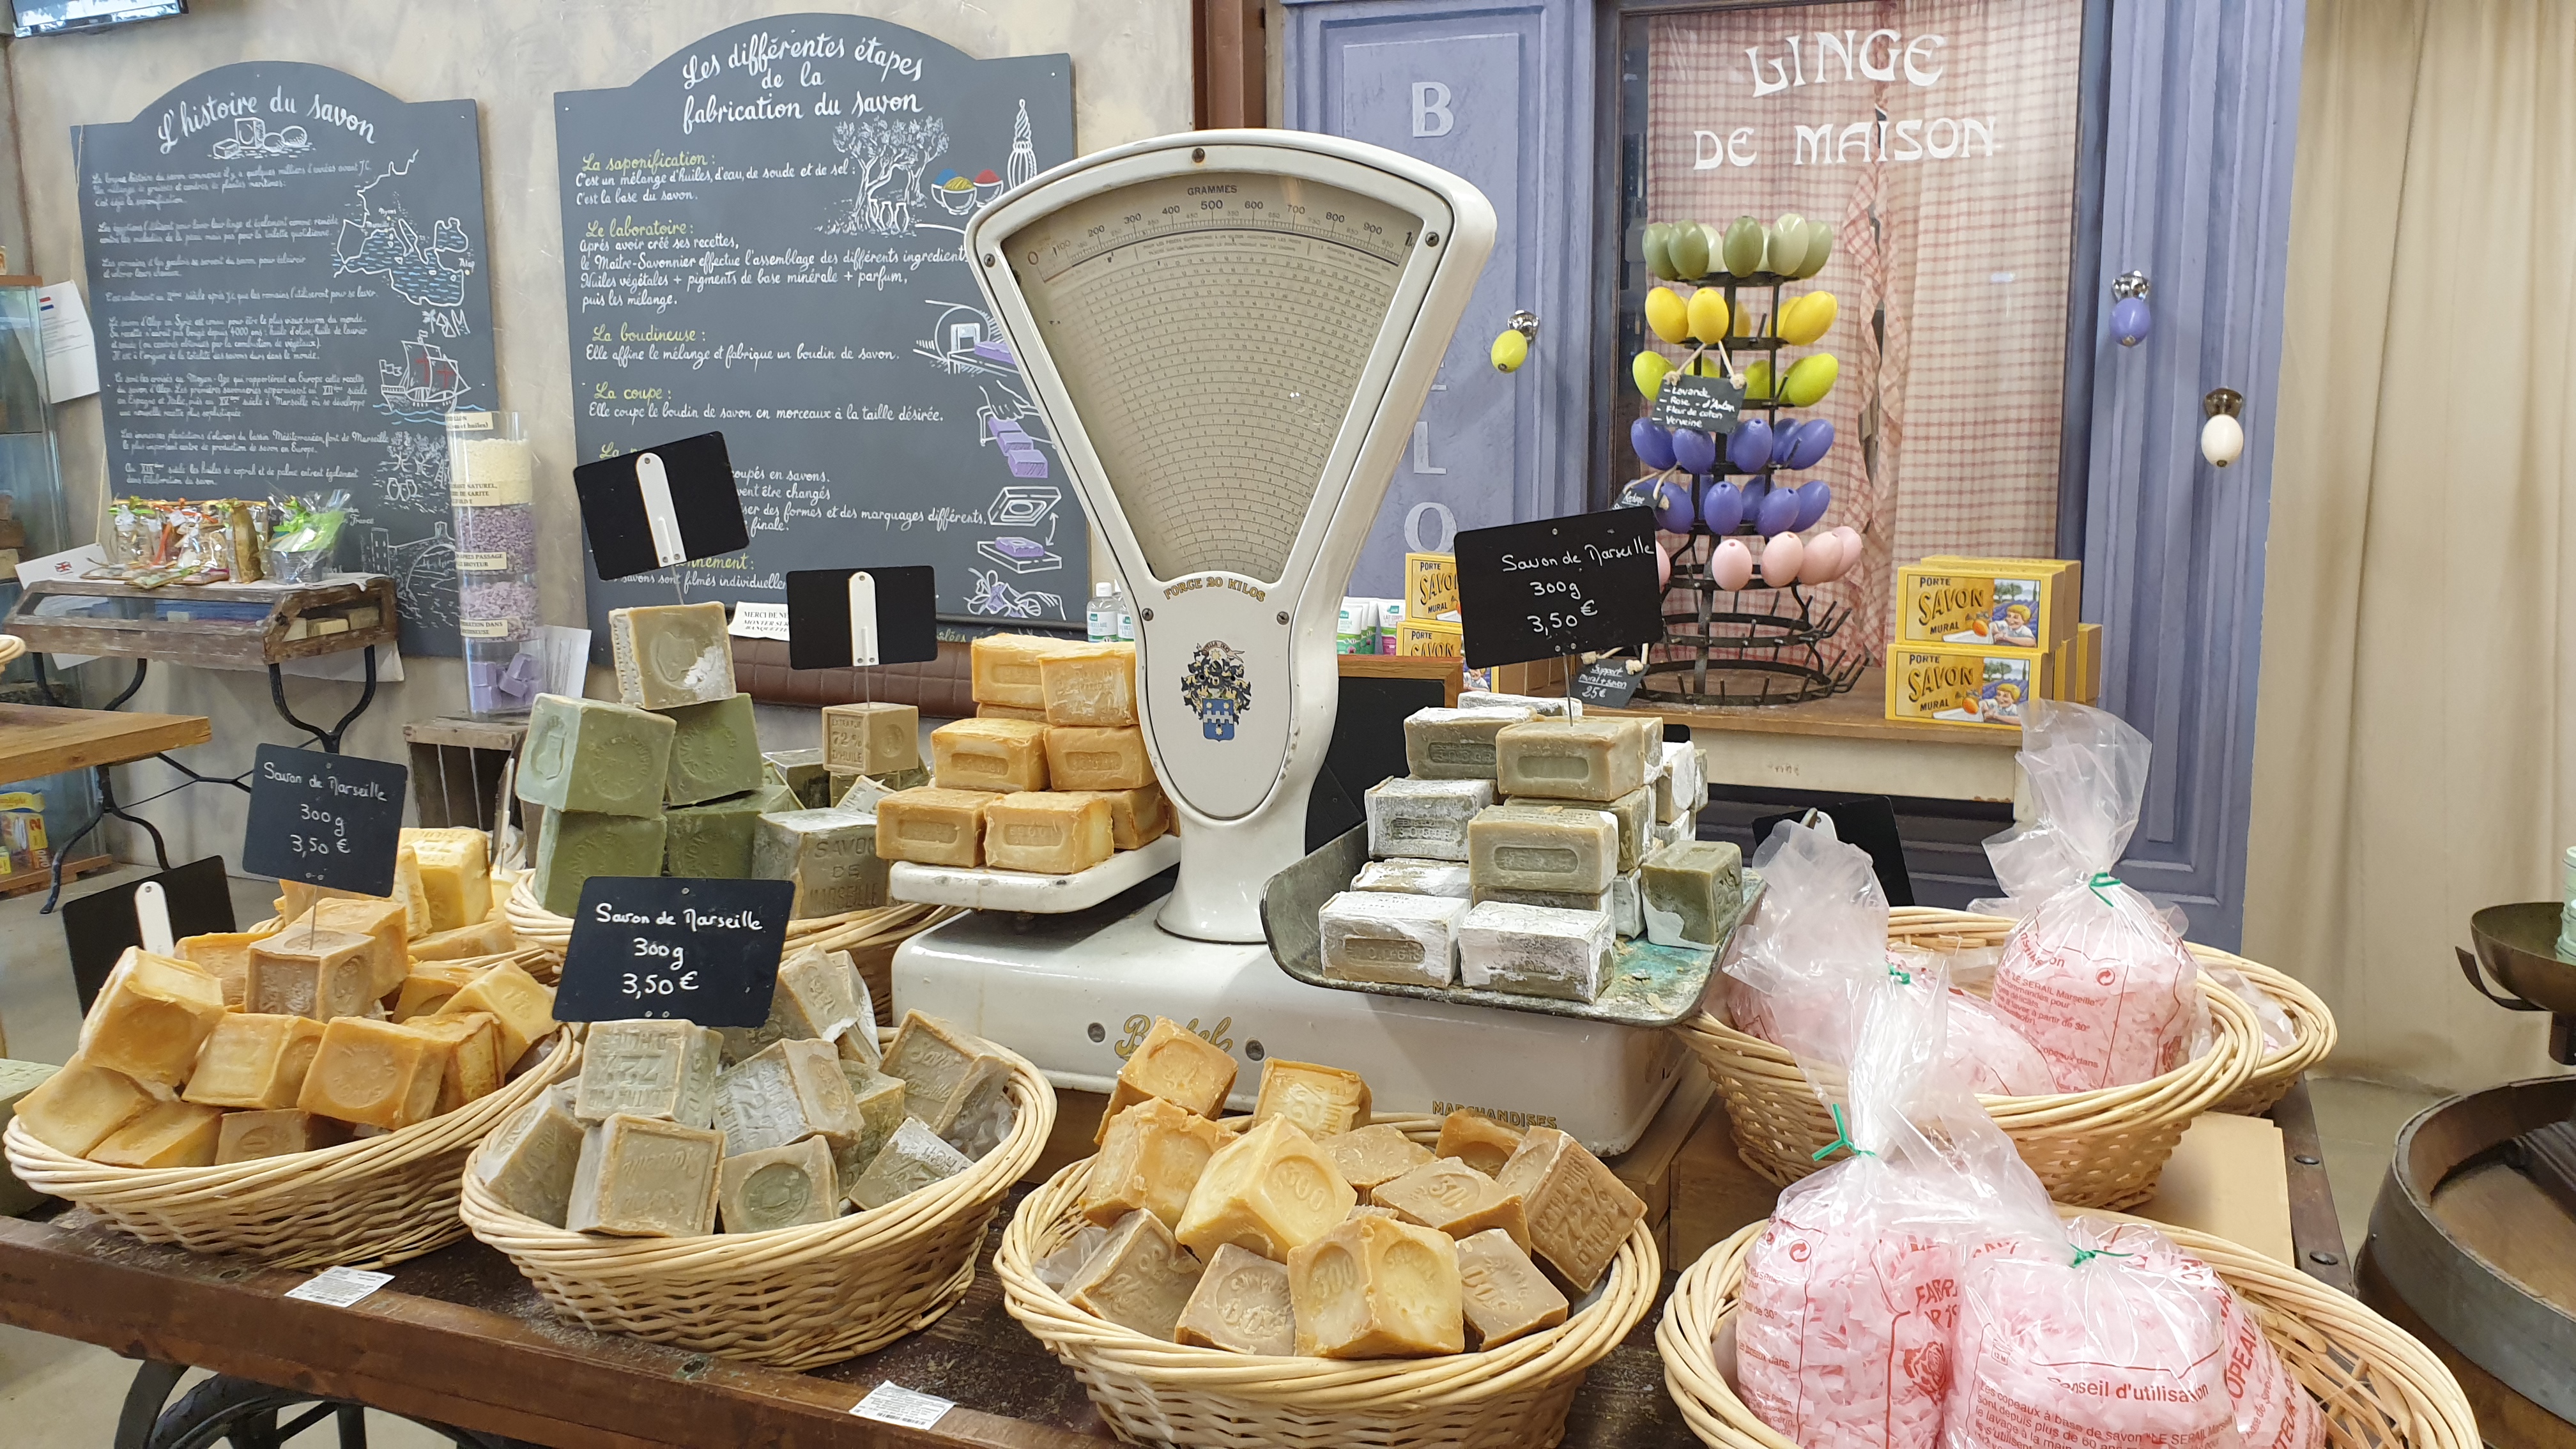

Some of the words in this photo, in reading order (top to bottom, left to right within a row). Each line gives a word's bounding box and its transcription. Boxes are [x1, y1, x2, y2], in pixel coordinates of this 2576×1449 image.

[683, 55, 721, 89] Les
[728, 32, 845, 76] différentes
[855, 36, 923, 82] étapes
[1745, 29, 1948, 98] LINGE
[761, 68, 784, 89] de
[800, 61, 825, 87] la
[158, 91, 257, 155] L'histoire
[270, 85, 297, 113] du
[307, 94, 376, 144] savon
[683, 93, 804, 134] fabrication
[815, 92, 841, 116] du
[851, 91, 924, 118] savon
[1693, 128, 1757, 170] DE
[1794, 116, 1995, 165] MAISON
[576, 172, 600, 187] C'est
[602, 175, 615, 186] un
[620, 171, 667, 190] mélange
[669, 165, 714, 183] d'huiles,
[715, 166, 744, 182] d'eau,
[746, 166, 758, 180] de
[762, 162, 795, 180] soude
[800, 163, 813, 177] et
[815, 162, 827, 176] de
[830, 159, 848, 176] sel
[582, 152, 601, 171] La
[606, 149, 708, 176] saponification
[576, 193, 599, 205] C'est
[601, 190, 611, 204] la
[615, 188, 638, 203] base
[642, 187, 657, 201] du
[661, 190, 698, 201] savon.
[1187, 185, 1238, 195] GRAMMES
[586, 219, 605, 238] Le
[610, 215, 687, 237] laboratoire
[1088, 224, 1105, 238] 200
[1124, 213, 1142, 224] 300
[1162, 205, 1180, 215] 400
[1200, 200, 1223, 210] 500
[1245, 201, 1264, 210] 600
[1287, 204, 1305, 215] 700
[1326, 211, 1345, 222] 800
[1363, 222, 1383, 235] 900
[615, 239, 645, 251] avoir
[672, 237, 691, 250] ses
[694, 233, 739, 249] recettes,
[580, 255, 591, 270] le
[699, 249, 741, 274] effectue
[745, 248, 818, 271] l'assemblage
[820, 250, 838, 264] des
[843, 247, 899, 271] différents
[619, 272, 669, 294] végétales
[687, 270, 737, 293] pigments
[741, 270, 753, 285] de
[757, 268, 781, 284] base
[786, 266, 838, 284] minérale
[857, 265, 908, 291] parfum,
[582, 292, 606, 313] puis
[608, 291, 624, 307] les
[627, 290, 678, 312] mélange.
[592, 323, 613, 342] La
[620, 321, 697, 342] boudineuse
[586, 343, 608, 360] Elle
[612, 345, 645, 368] affine
[648, 344, 659, 360] le
[663, 343, 710, 370] mélange
[714, 345, 724, 360] et
[725, 342, 774, 372] fabrique
[777, 349, 792, 360] un
[797, 342, 836, 360] boudin
[841, 346, 854, 360] de
[857, 348, 900, 360] savon.
[594, 381, 617, 400] La
[624, 387, 663, 407] coupe
[589, 402, 610, 417] Elle
[614, 407, 645, 425] coupe
[648, 401, 659, 417] le
[662, 401, 698, 418] boudin
[703, 404, 717, 418] de
[719, 407, 753, 419] savon
[756, 410, 770, 419] en
[776, 409, 831, 420] morceaux
[834, 408, 843, 420] à
[847, 404, 859, 420] la
[862, 403, 894, 420] taille
[899, 406, 944, 422] désirée.
[770, 471, 783, 480] en
[786, 468, 830, 482] savons.
[762, 486, 781, 499] être
[786, 483, 831, 506] changés
[751, 516, 789, 538] finale.
[763, 503, 779, 517] des
[784, 501, 822, 523] formes
[827, 506, 839, 518] et
[840, 505, 857, 518] des
[862, 510, 924, 531] marquages
[928, 507, 987, 532] différents.
[1420, 562, 1441, 571] PORTE
[1501, 554, 1558, 572] Savon
[1563, 551, 1581, 564] de
[684, 571, 716, 594] filmés
[1206, 576, 1223, 588] 20
[1228, 578, 1266, 602] KILOS
[1920, 577, 1951, 588] PORTE
[1428, 602, 1448, 613] MURAL
[1919, 588, 1984, 626] SAVON
[1412, 631, 1432, 640] PORTE
[1930, 622, 1959, 634] MURAL
[1910, 654, 1940, 665] PORTE
[1908, 666, 1973, 702] SAVON
[1920, 698, 1949, 712] MURAL
[264, 762, 302, 784] Savon
[309, 774, 322, 788] de
[595, 903, 650, 923] Savon
[656, 911, 676, 926] de
[1981, 1380, 1997, 1397] Les
[1998, 1391, 2041, 1418] copeaux
[2044, 1409, 2051, 1421] à
[2055, 1413, 2083, 1433] base
[2086, 1425, 2102, 1439] de
[2106, 1429, 2142, 1443] savon
[1986, 1407, 2019, 1436] lavage
[1999, 1404, 2032, 1429] depuis
[2034, 1420, 2060, 1439] plus
[2063, 1428, 2078, 1442] de
[2082, 1436, 2096, 1447] 60
